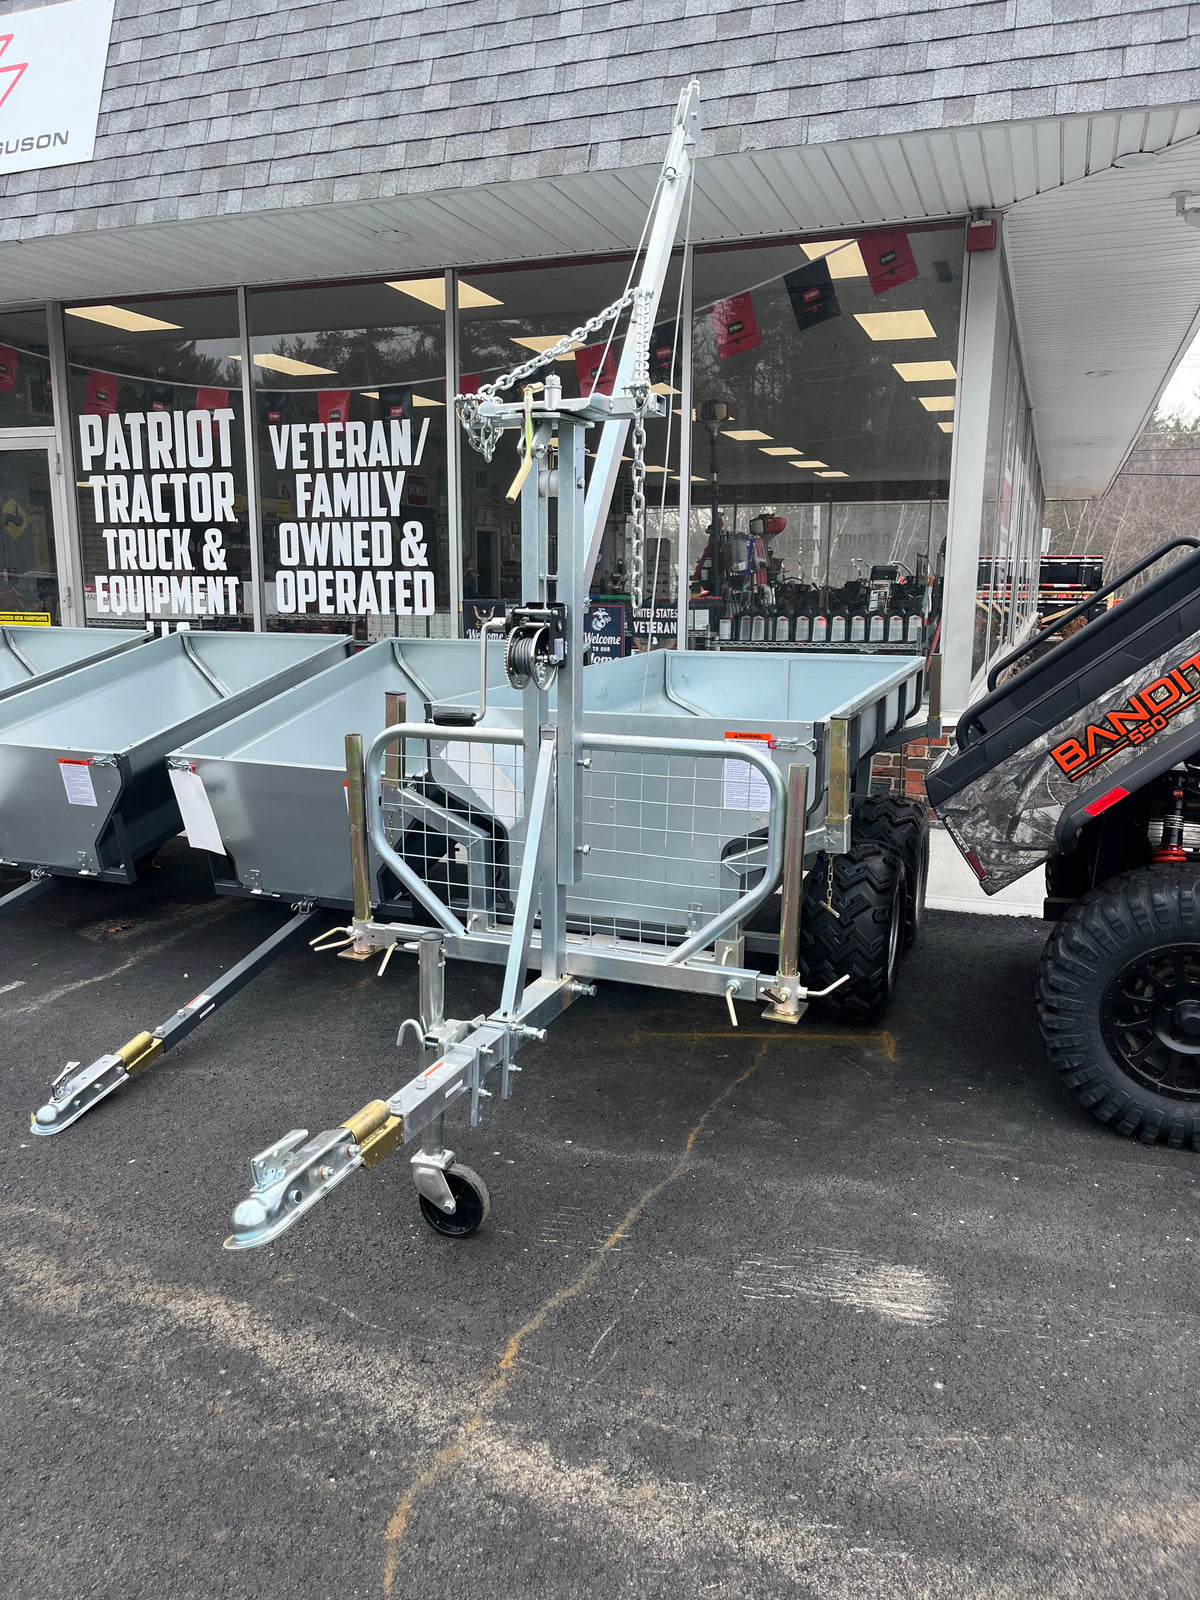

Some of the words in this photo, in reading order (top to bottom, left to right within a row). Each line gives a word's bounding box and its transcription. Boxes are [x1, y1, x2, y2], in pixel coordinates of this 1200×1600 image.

[0, 130, 69, 155] USON
[78, 408, 235, 471] PATRIOT
[268, 417, 431, 470] VETERAN/
[88, 472, 239, 524] TRACTOR,
[295, 470, 406, 518] FAMILY
[102, 528, 196, 571] TRUCK,
[202, 527, 228, 571] &
[278, 520, 393, 567] OWNED
[400, 520, 429, 568] &
[94, 575, 240, 616] EQUIPMENT
[275, 570, 435, 616] OPERATED
[655, 608, 679, 619] STATES
[583, 632, 621, 645] Welcome
[633, 621, 677, 634] VETERAN
[1128, 714, 1168, 745] 550
